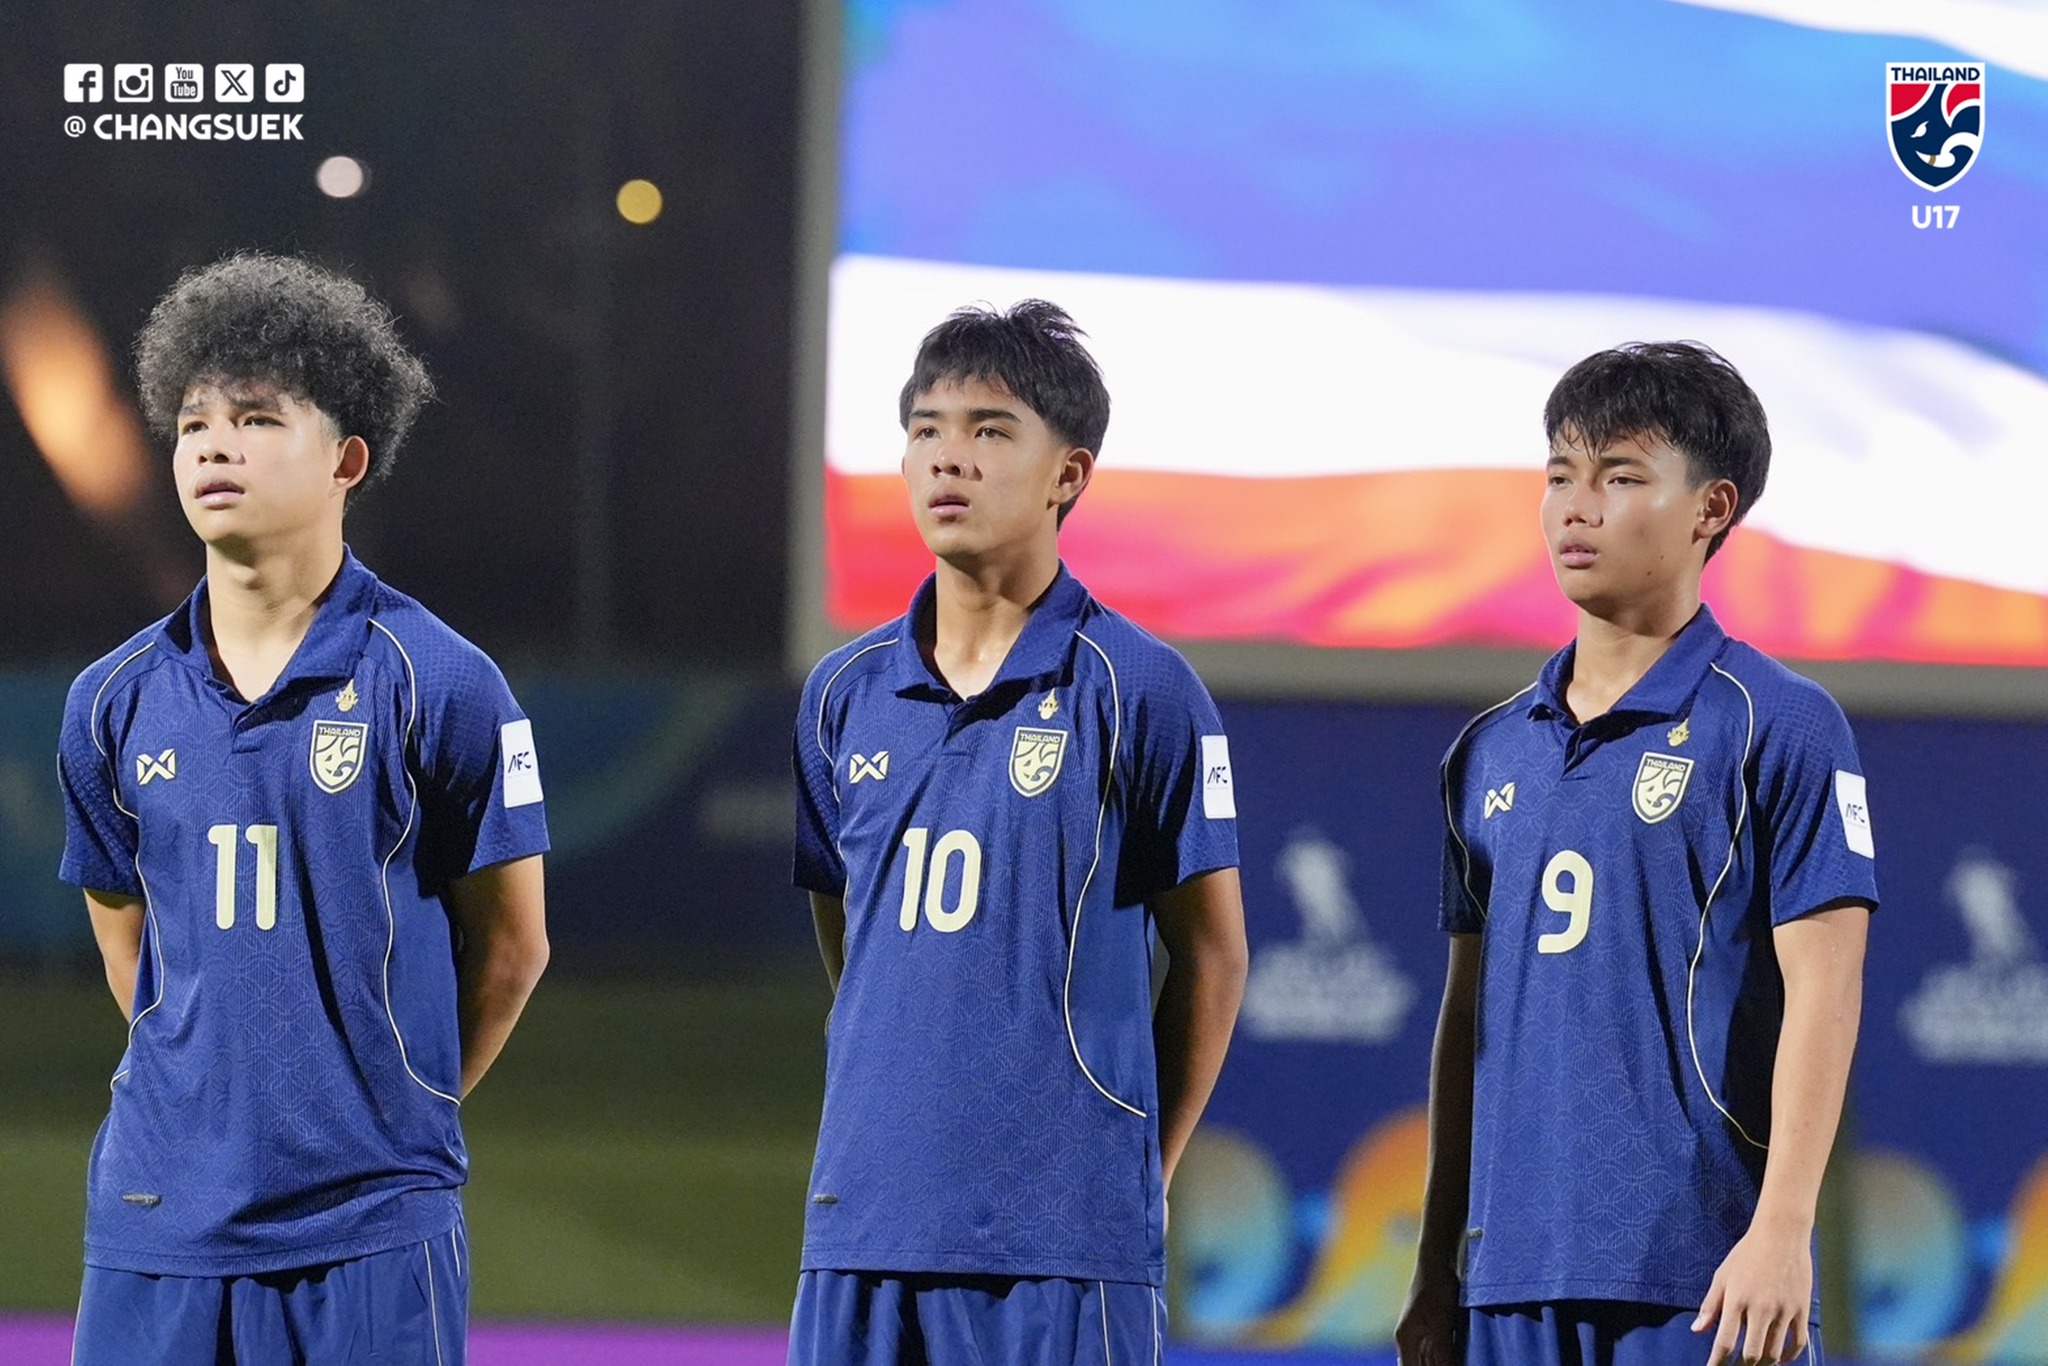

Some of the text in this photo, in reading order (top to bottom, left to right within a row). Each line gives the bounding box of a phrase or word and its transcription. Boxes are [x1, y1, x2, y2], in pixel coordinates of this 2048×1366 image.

[318, 726, 361, 737] THAILAND
[1020, 733, 1061, 744] THAILAND
[507, 751, 532, 773] AFC
[1646, 758, 1686, 772] THAILAND
[208, 824, 278, 930] 11
[900, 828, 982, 932] 10
[1537, 850, 1594, 954] 9
